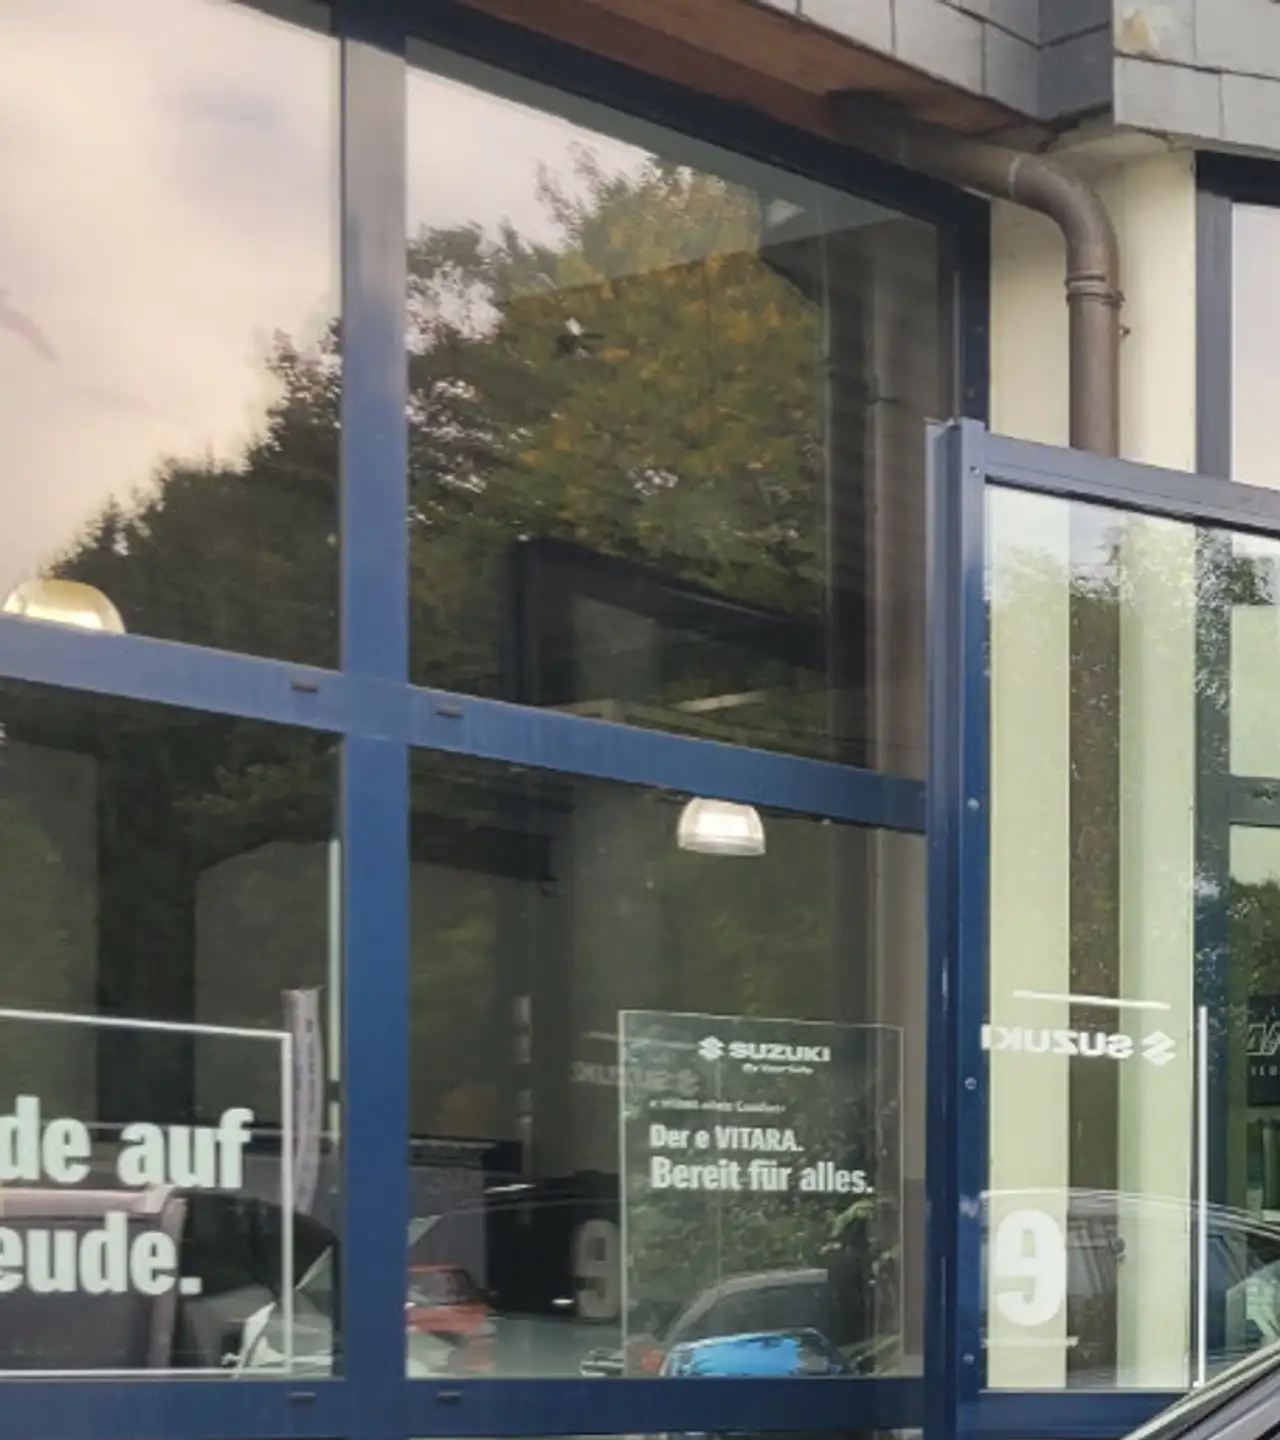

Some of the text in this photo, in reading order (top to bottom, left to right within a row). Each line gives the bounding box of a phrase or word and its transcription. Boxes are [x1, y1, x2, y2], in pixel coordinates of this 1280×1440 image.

[728, 1041, 831, 1062] SUZUKI
[0, 1094, 254, 1188] de auf
[650, 1124, 805, 1151] Der e VITARA.
[651, 1156, 874, 1194] Bereit für alles.
